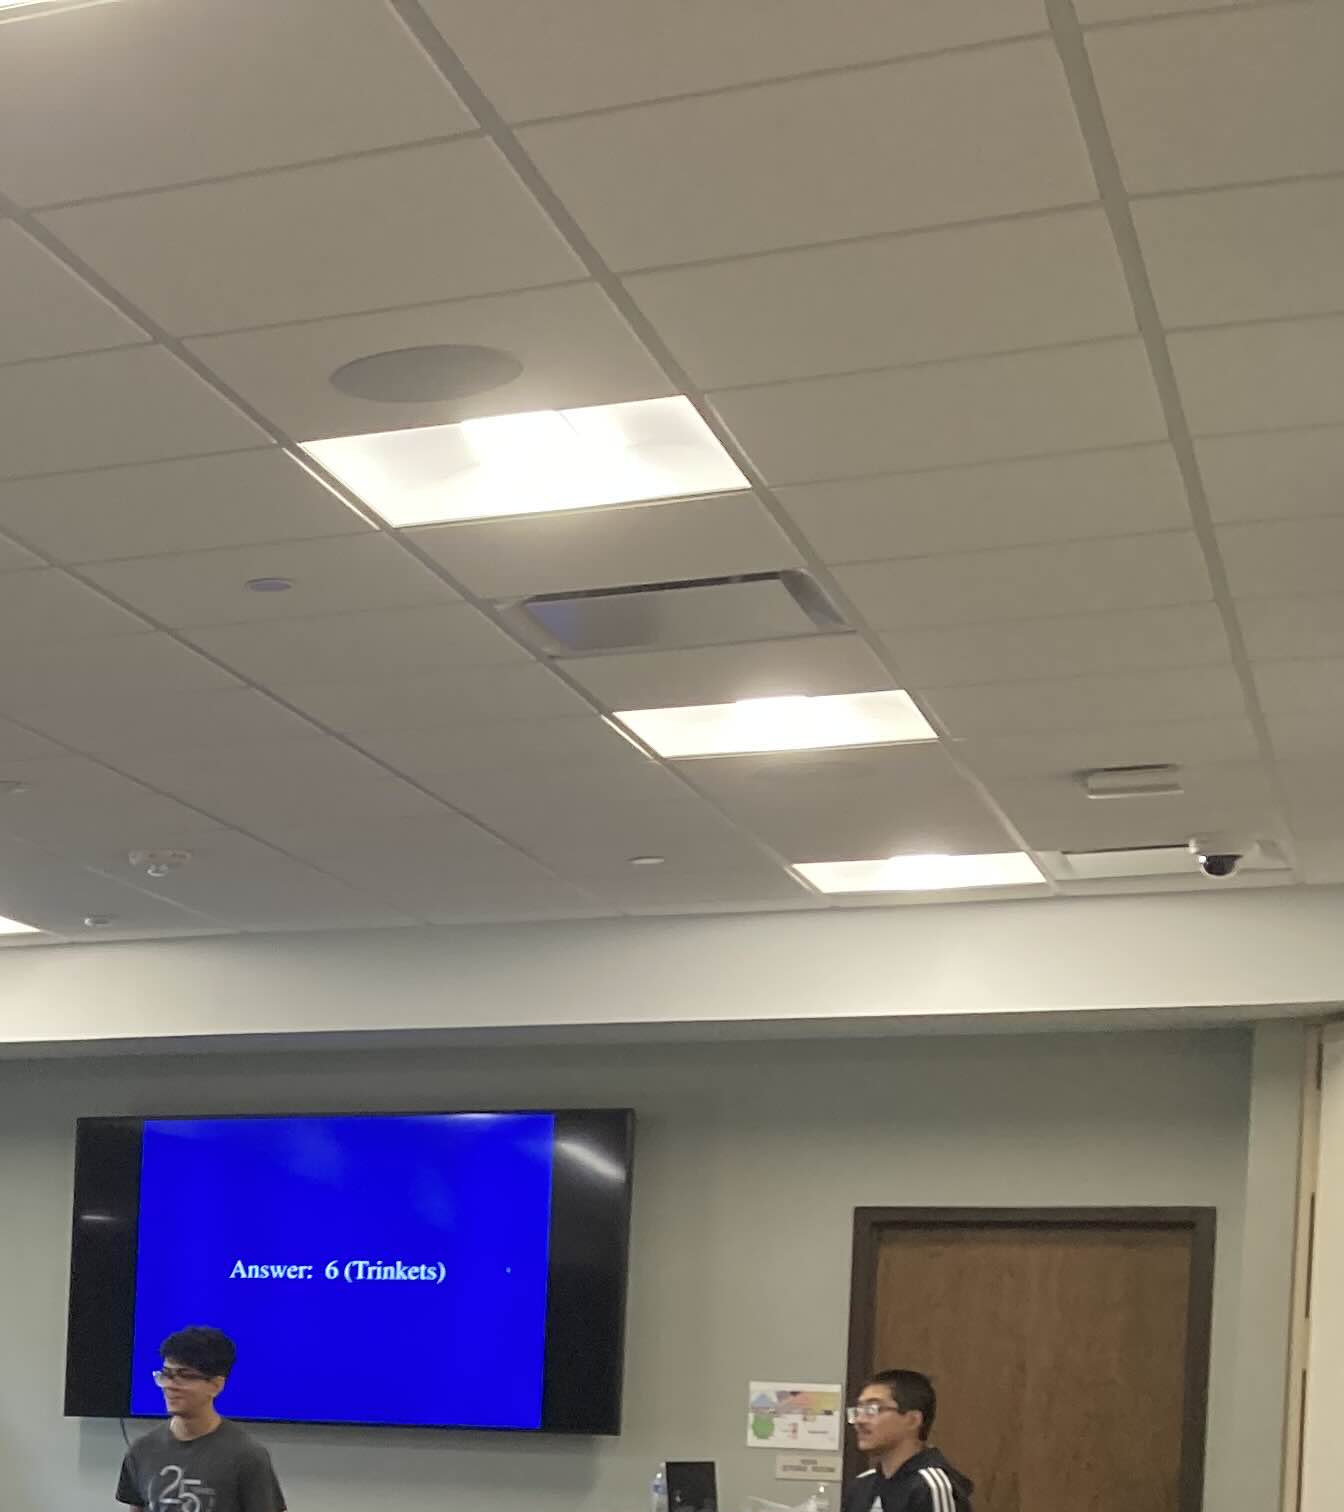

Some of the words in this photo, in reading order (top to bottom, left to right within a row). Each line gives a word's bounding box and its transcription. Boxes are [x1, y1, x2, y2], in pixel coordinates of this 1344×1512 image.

[229, 1259, 313, 1280] Answer:
[325, 1260, 339, 1280] 6
[344, 1260, 446, 1284] (Trinkets)
